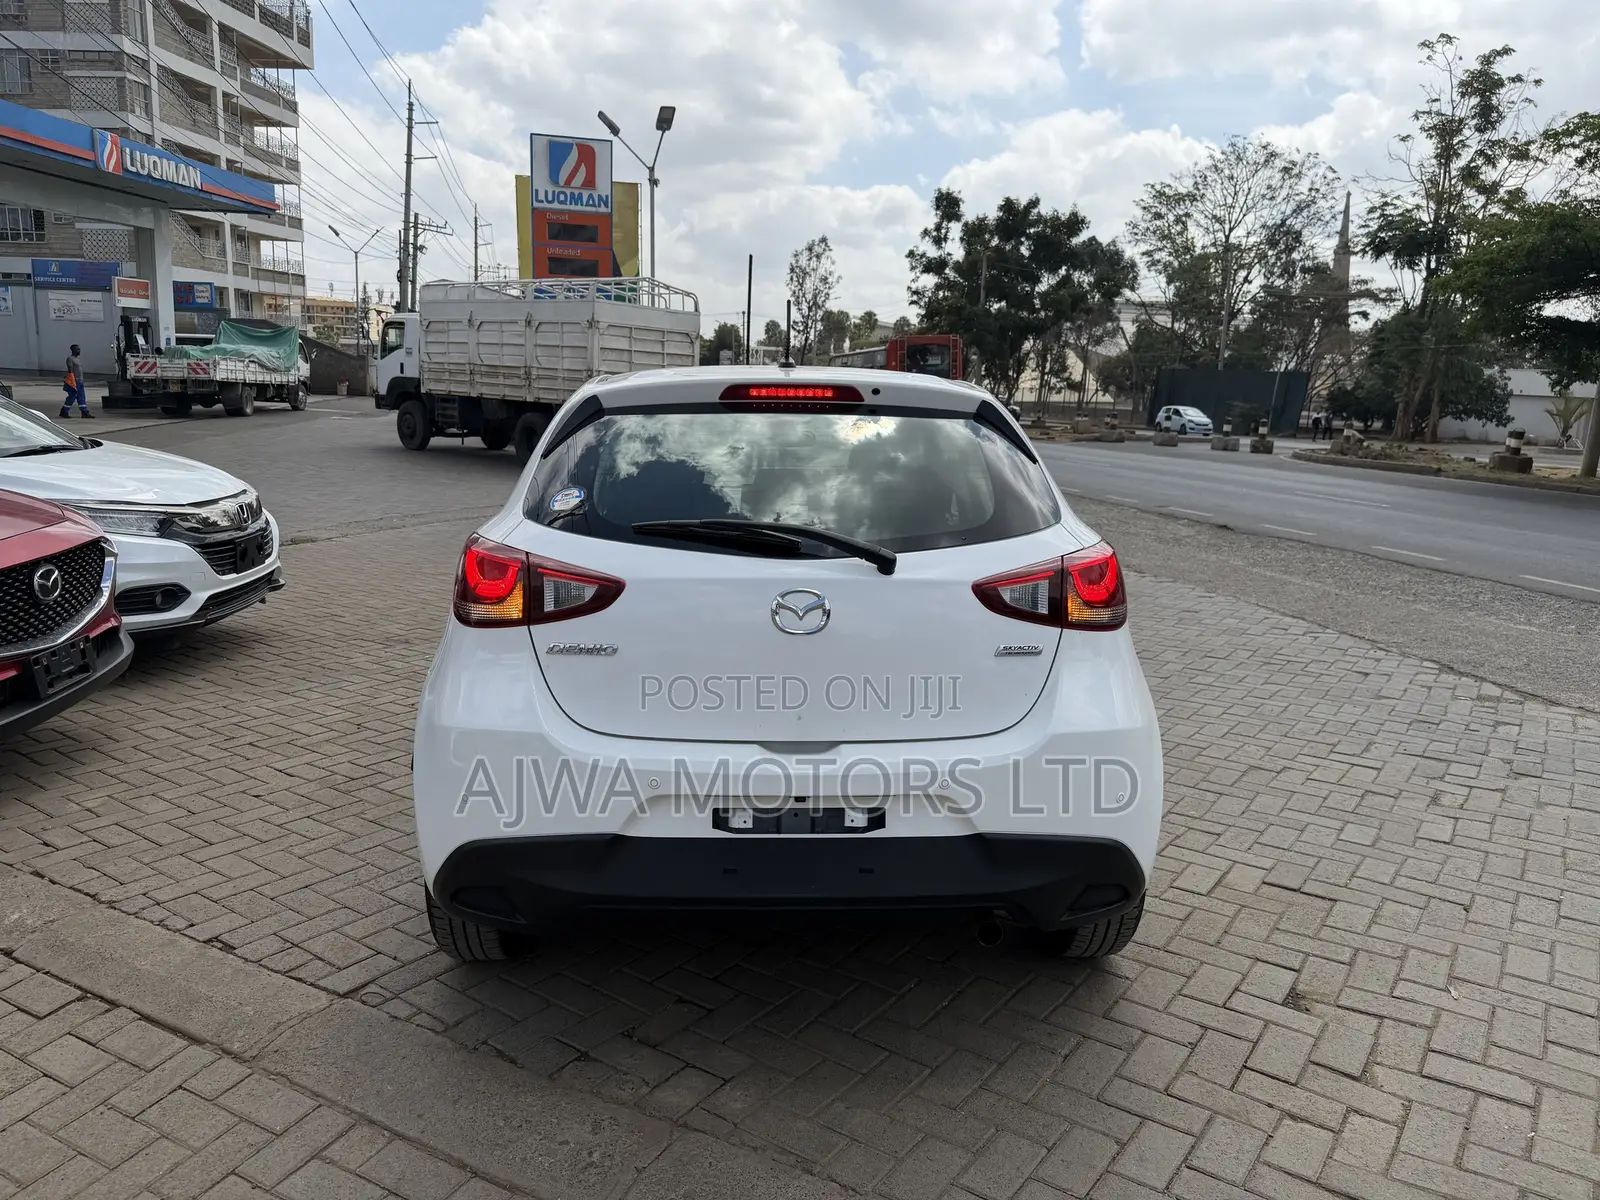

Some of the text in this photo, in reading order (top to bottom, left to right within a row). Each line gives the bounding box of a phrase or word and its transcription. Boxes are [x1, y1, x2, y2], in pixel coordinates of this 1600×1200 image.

[122, 147, 201, 190] LUQMAN
[534, 188, 610, 209] LUQMAN
[546, 212, 569, 221] Diesel
[546, 247, 581, 256] Unleaded
[546, 642, 618, 656] DEMIO
